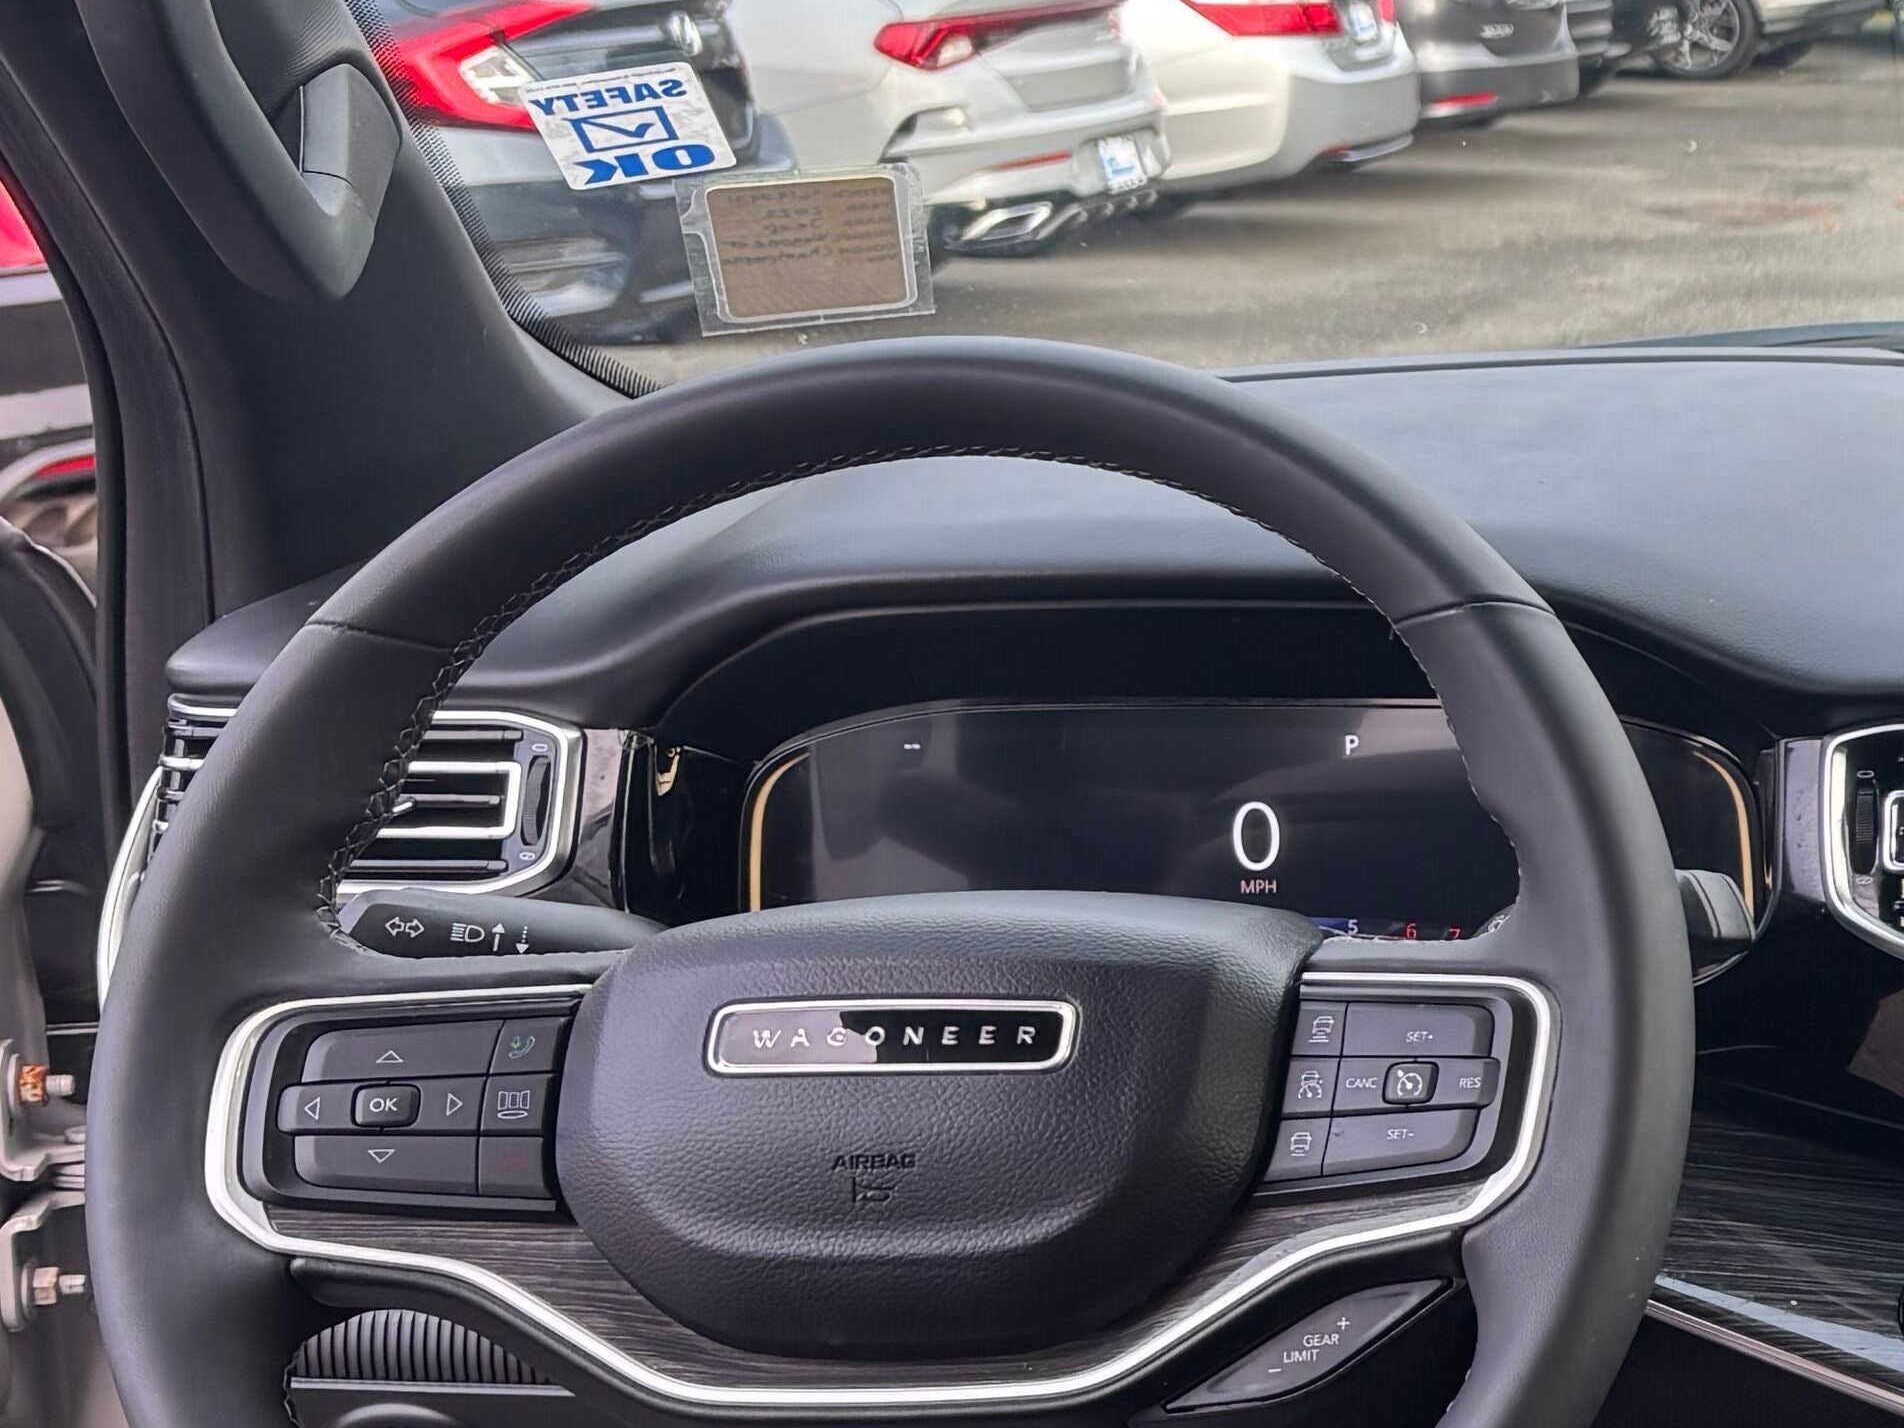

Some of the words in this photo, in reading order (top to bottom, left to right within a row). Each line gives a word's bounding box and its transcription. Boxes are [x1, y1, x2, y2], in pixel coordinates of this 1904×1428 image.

[1344, 734, 1360, 757] P
[1231, 801, 1280, 873] 0
[1240, 878, 1278, 895] MPH
[1348, 919, 1359, 934] 5
[1405, 923, 1417, 939] 6
[752, 1025, 1037, 1050] WAGONEER
[1345, 1077, 1379, 1089] CANC
[1458, 1076, 1481, 1089] RES
[369, 1095, 398, 1115] OK
[831, 1152, 917, 1172] AIRBAG
[1302, 1332, 1340, 1347] GEAR
[1283, 1348, 1320, 1363] LIMIT
